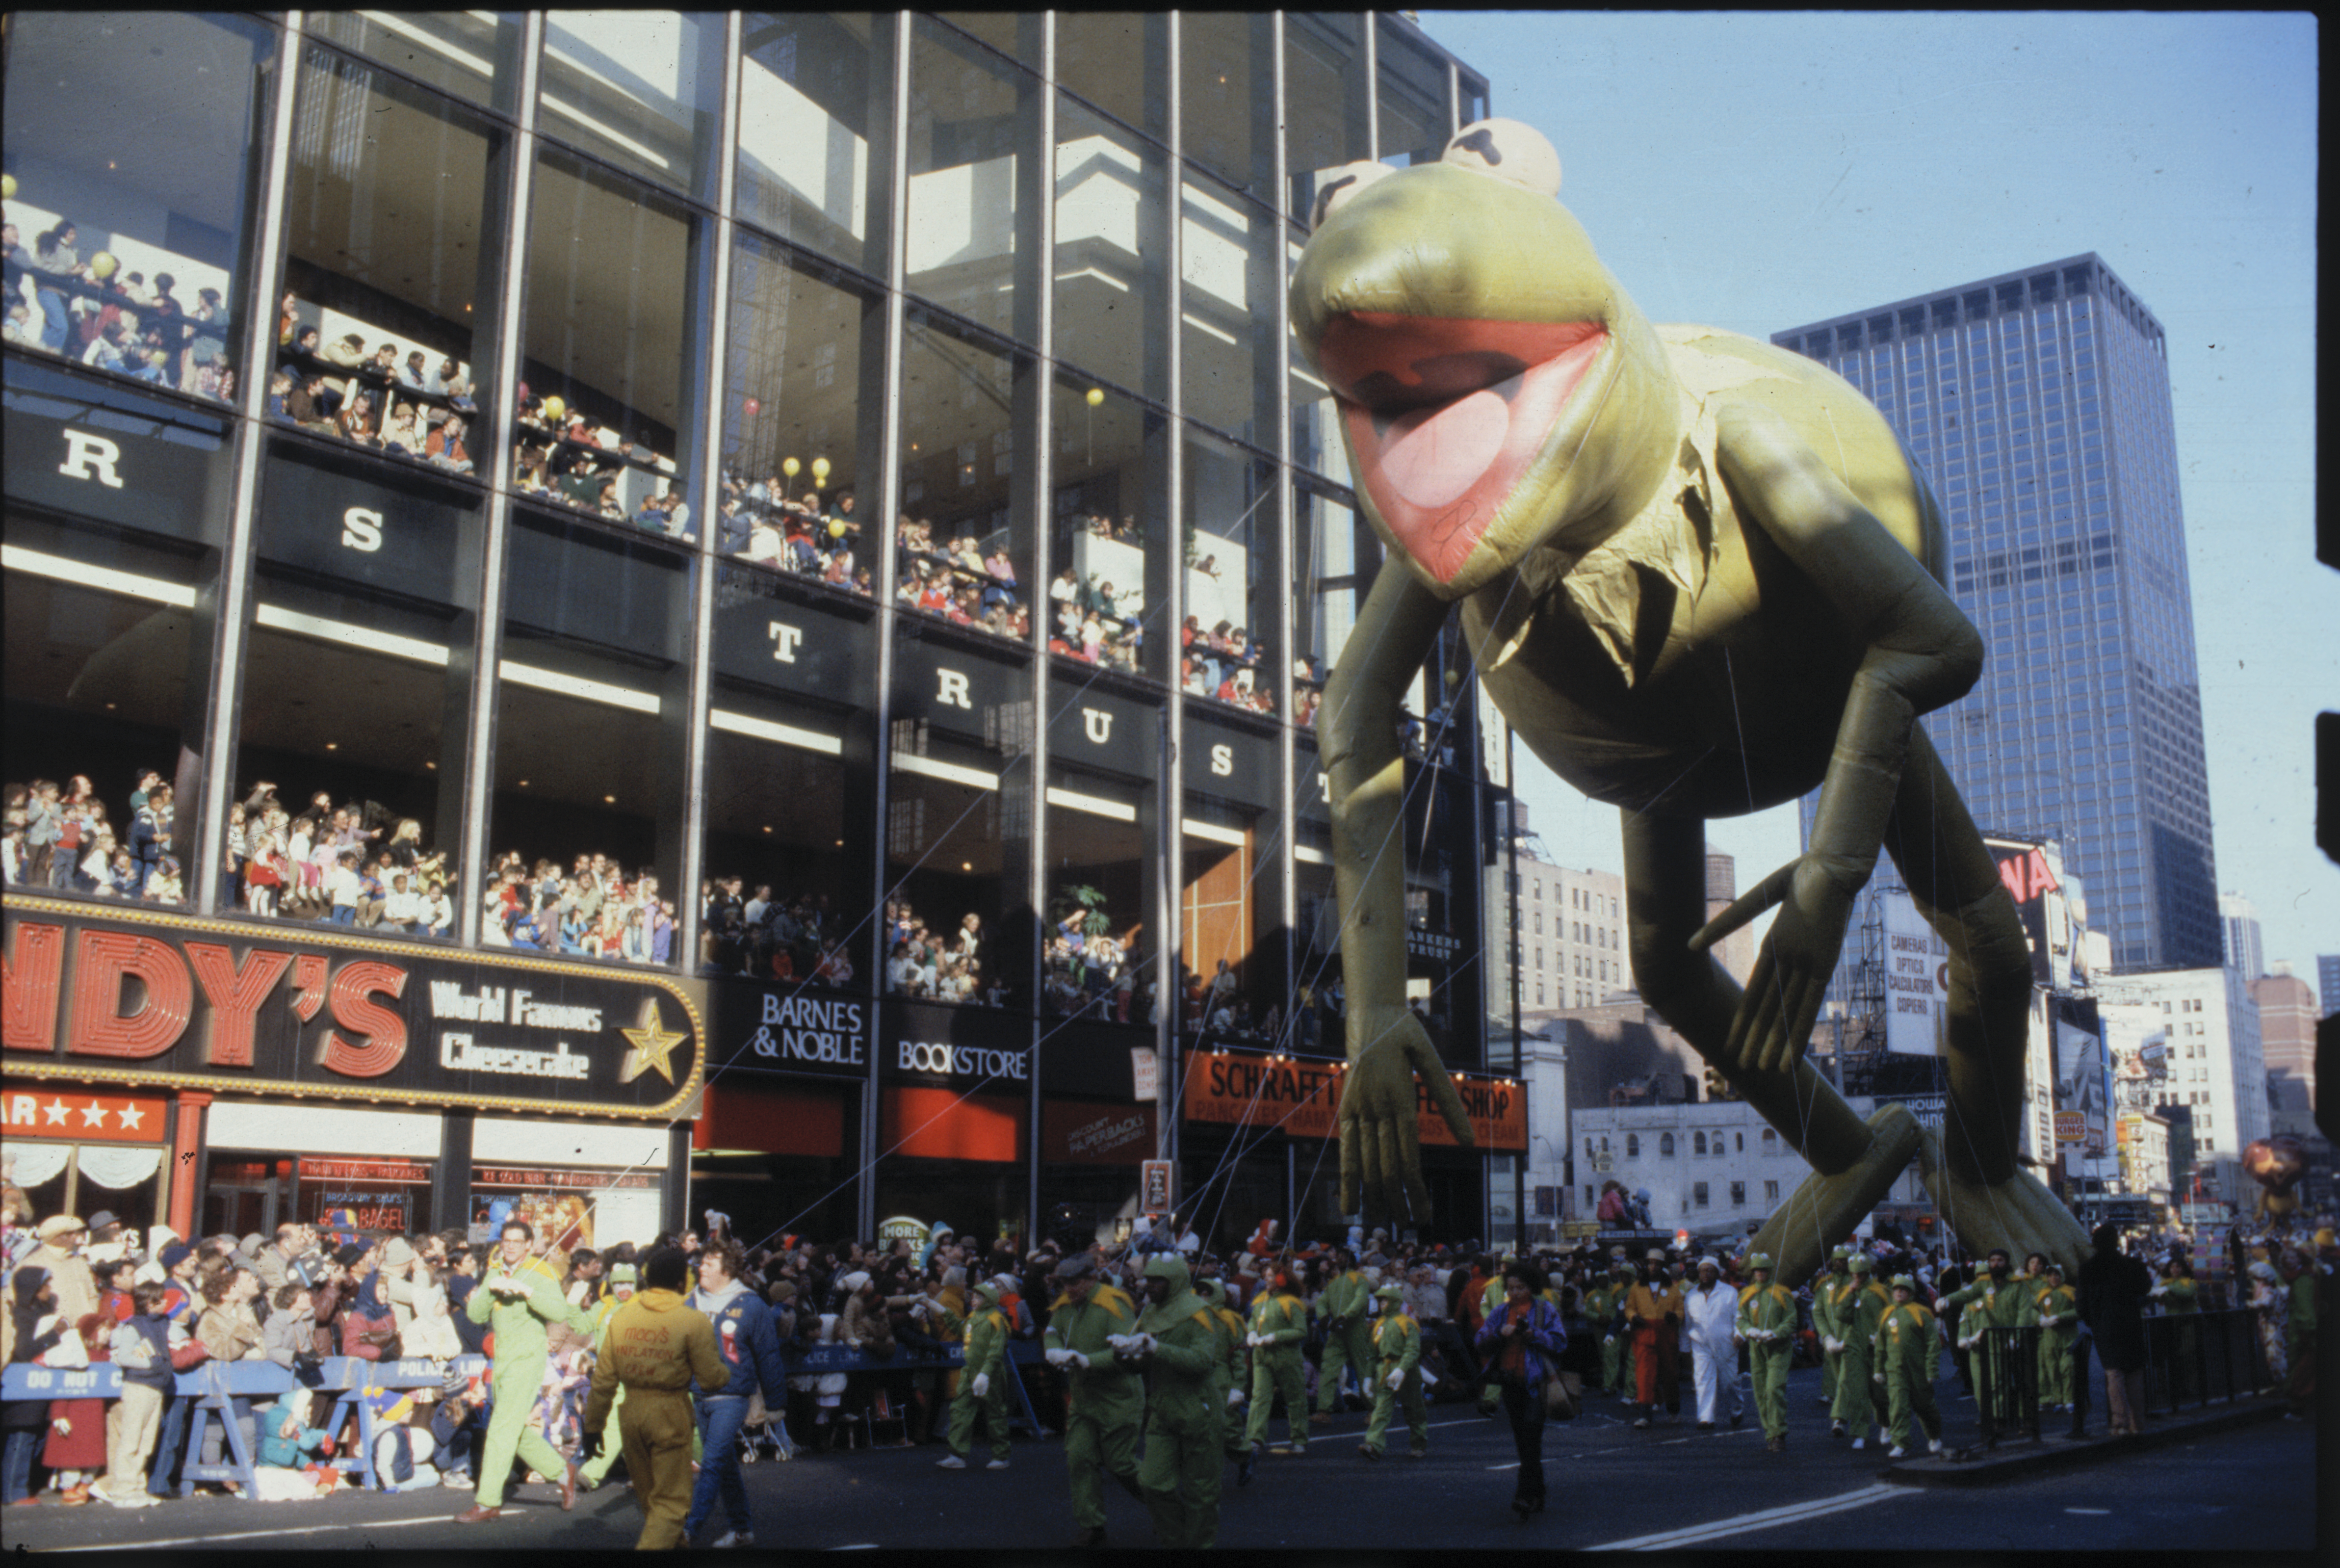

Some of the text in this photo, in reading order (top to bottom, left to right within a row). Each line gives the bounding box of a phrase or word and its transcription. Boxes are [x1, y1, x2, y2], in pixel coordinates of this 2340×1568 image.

[1407, 931, 1461, 949] ANKERS
[1891, 934, 1928, 954] CAMERAS
[1409, 943, 1452, 960] TRUST
[1896, 956, 1924, 974] OPTICS
[1888, 974, 1934, 995] CALCULATORS
[430, 980, 602, 1032] World Famous
[761, 993, 862, 1035] BARNES
[1896, 997, 1928, 1015] COPIERS
[754, 1025, 864, 1065] & NOBLE
[440, 1031, 590, 1080] Cheesecake
[898, 1040, 1028, 1080] BOOKSTORE
[1138, 1054, 1153, 1064] TOW
[1137, 1067, 1155, 1077] AWAY
[1137, 1080, 1155, 1091] ZONE
[1210, 1060, 1344, 1107] SCHRAFFT'
[1461, 1086, 1510, 1120] SHOP
[1906, 1098, 1946, 1111] HOWA
[2054, 1116, 2085, 1125] BURGER
[2055, 1125, 2085, 1135] KING
[482, 1170, 496, 1183] ICE
[499, 1171, 522, 1184] COLD
[325, 1193, 403, 1204] BROADWAY SAM'S
[358, 1207, 406, 1230] BAGEL
[883, 1225, 920, 1238] MORE
[878, 1238, 924, 1251] BKS
[616, 1346, 673, 1360] INFLATION
[805, 1351, 829, 1364] LICE
[398, 1360, 448, 1377] POLICE
[625, 1364, 657, 1376] CREW
[27, 1369, 53, 1389] DO
[63, 1370, 98, 1389] NOT
